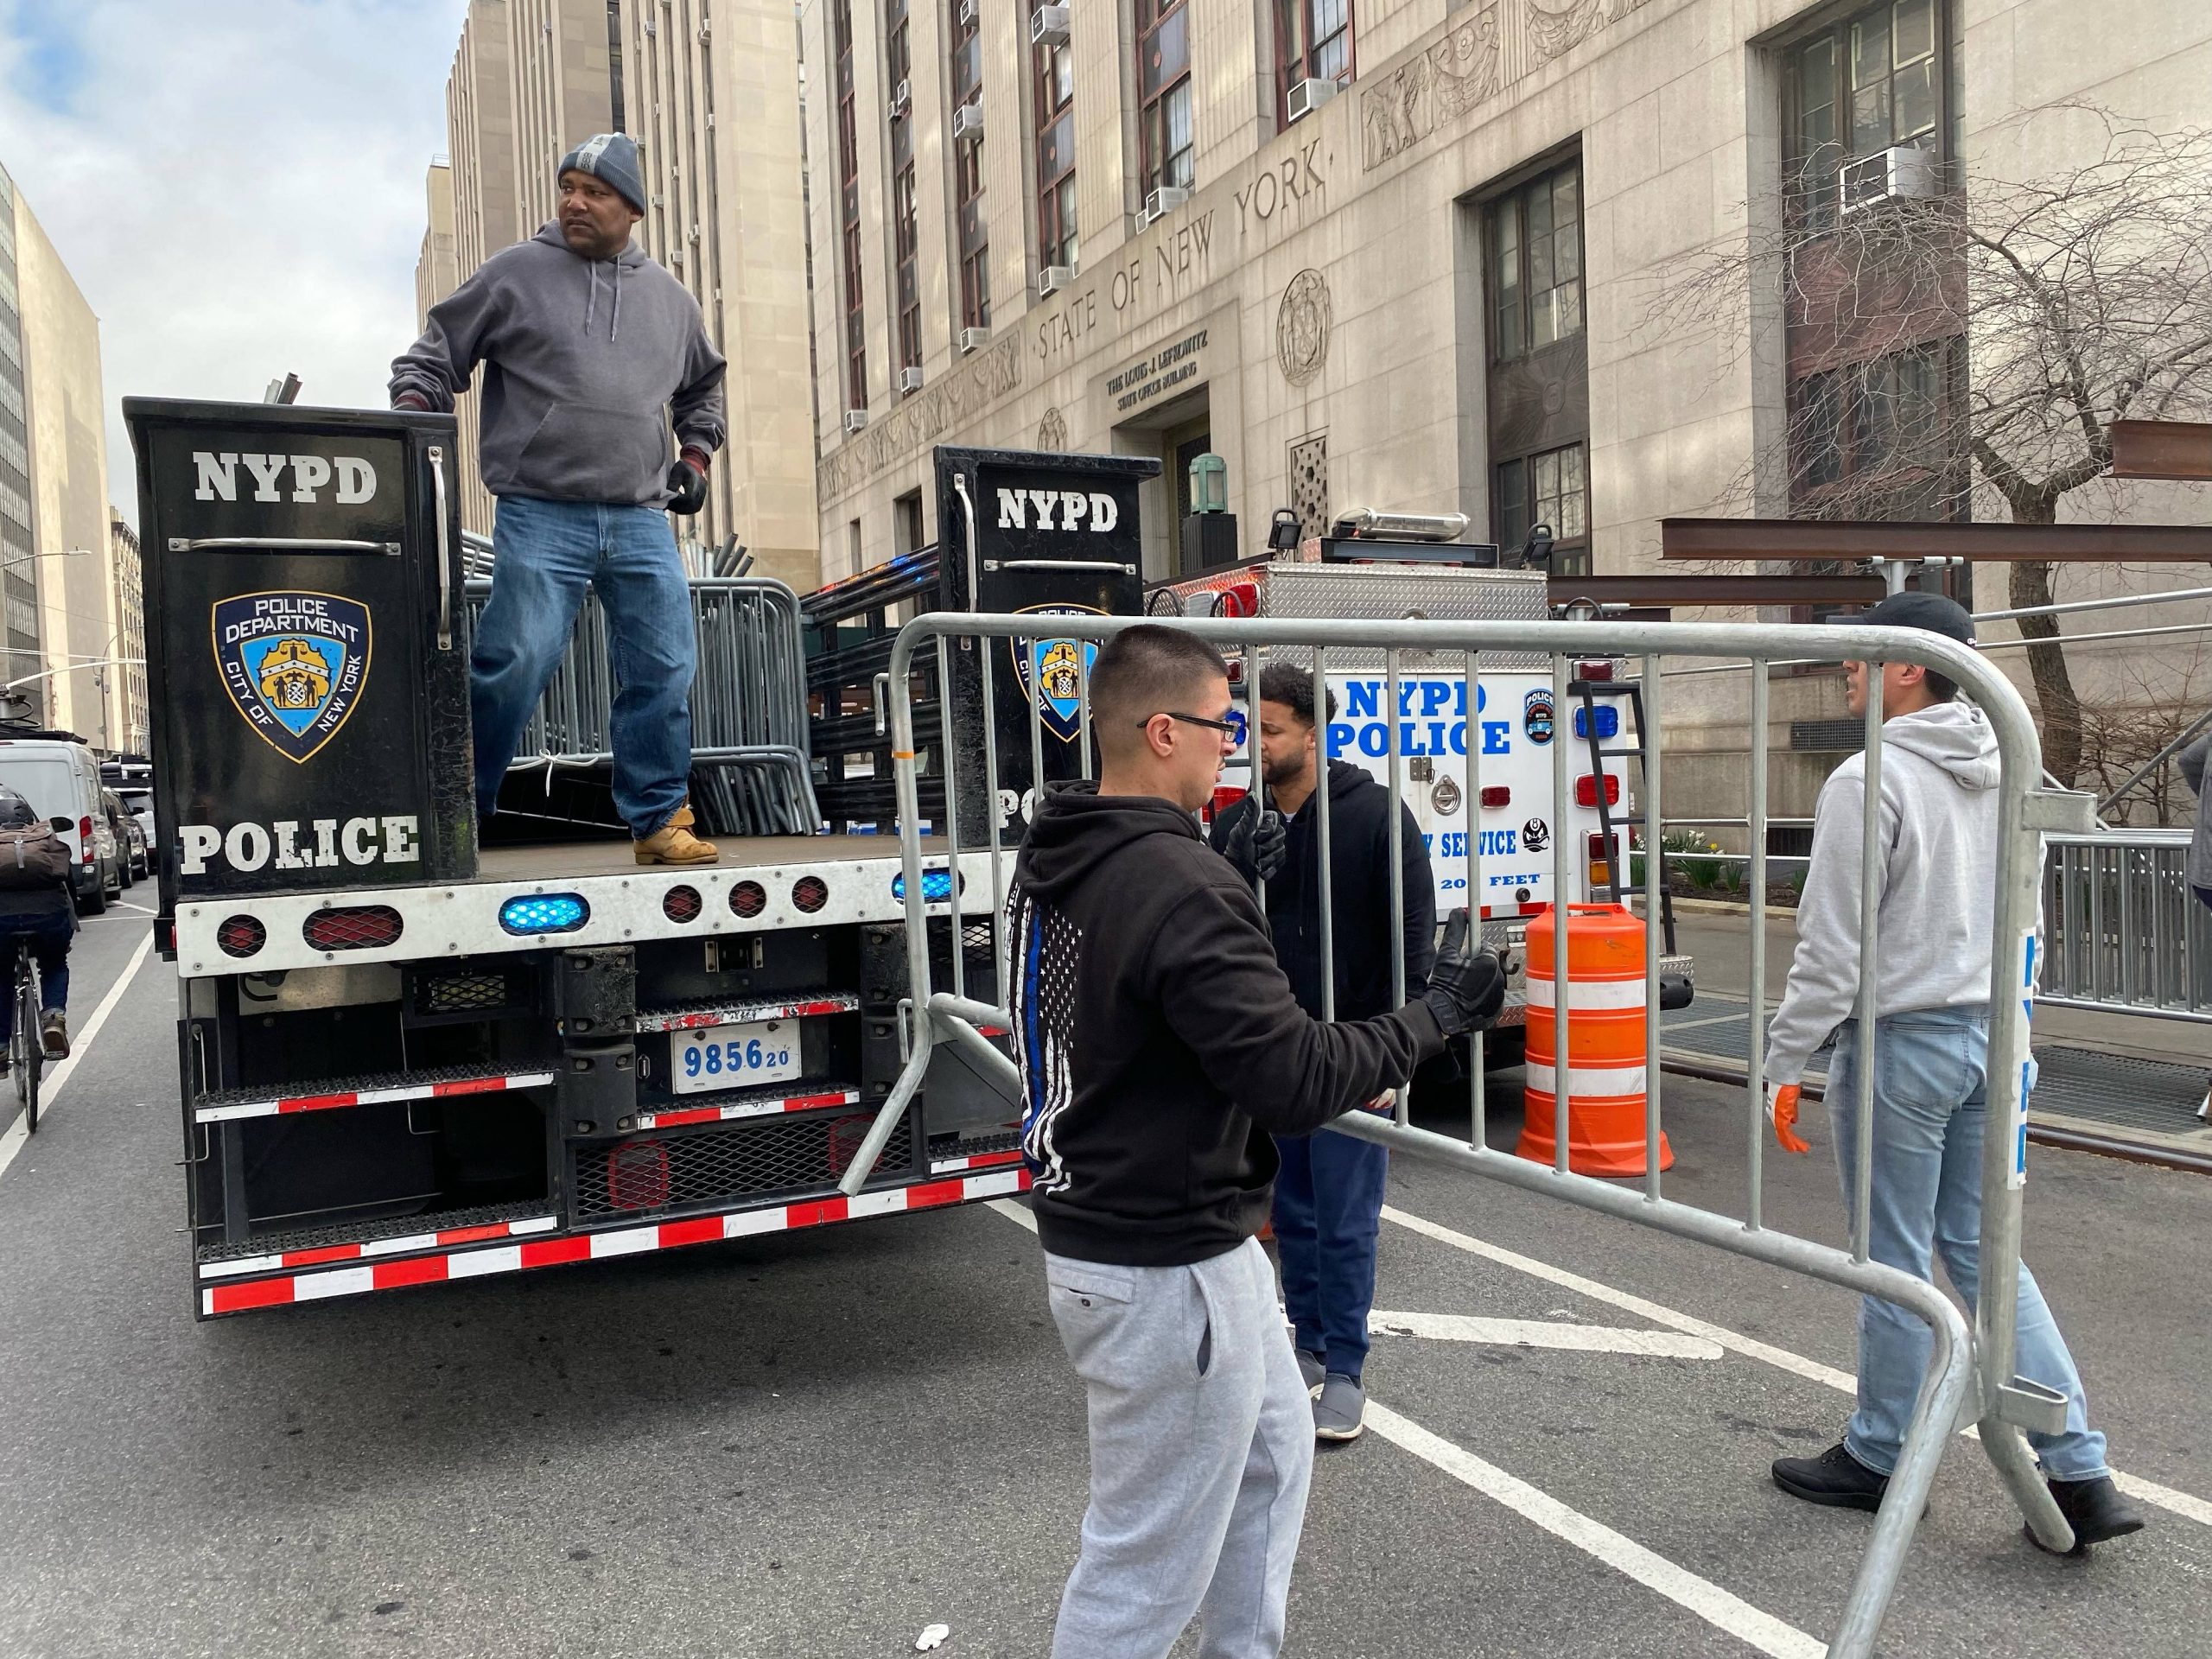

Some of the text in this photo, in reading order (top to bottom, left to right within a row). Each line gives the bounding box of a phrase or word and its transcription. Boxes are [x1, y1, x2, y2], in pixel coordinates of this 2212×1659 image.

[1039, 137, 1325, 359] STATE OF NEW YORK
[1106, 329, 1208, 396] THE LOUIS J. LEFKOWITZ
[1117, 361, 1197, 411] STATE OFFICE BUILDING
[193, 452, 378, 504] NYPD
[997, 488, 1118, 532] NYPD
[255, 599, 327, 616] POLICE
[226, 615, 359, 644] DEPARTMENT
[226, 655, 361, 732] CITY OF NEW YORK
[1346, 682, 1486, 717] NYPD
[1326, 721, 1510, 758] POLICE
[179, 816, 420, 874] POLICE
[1441, 879, 1466, 889] 20
[1490, 874, 1541, 887] FEET
[684, 1039, 788, 1077] 9856 20
